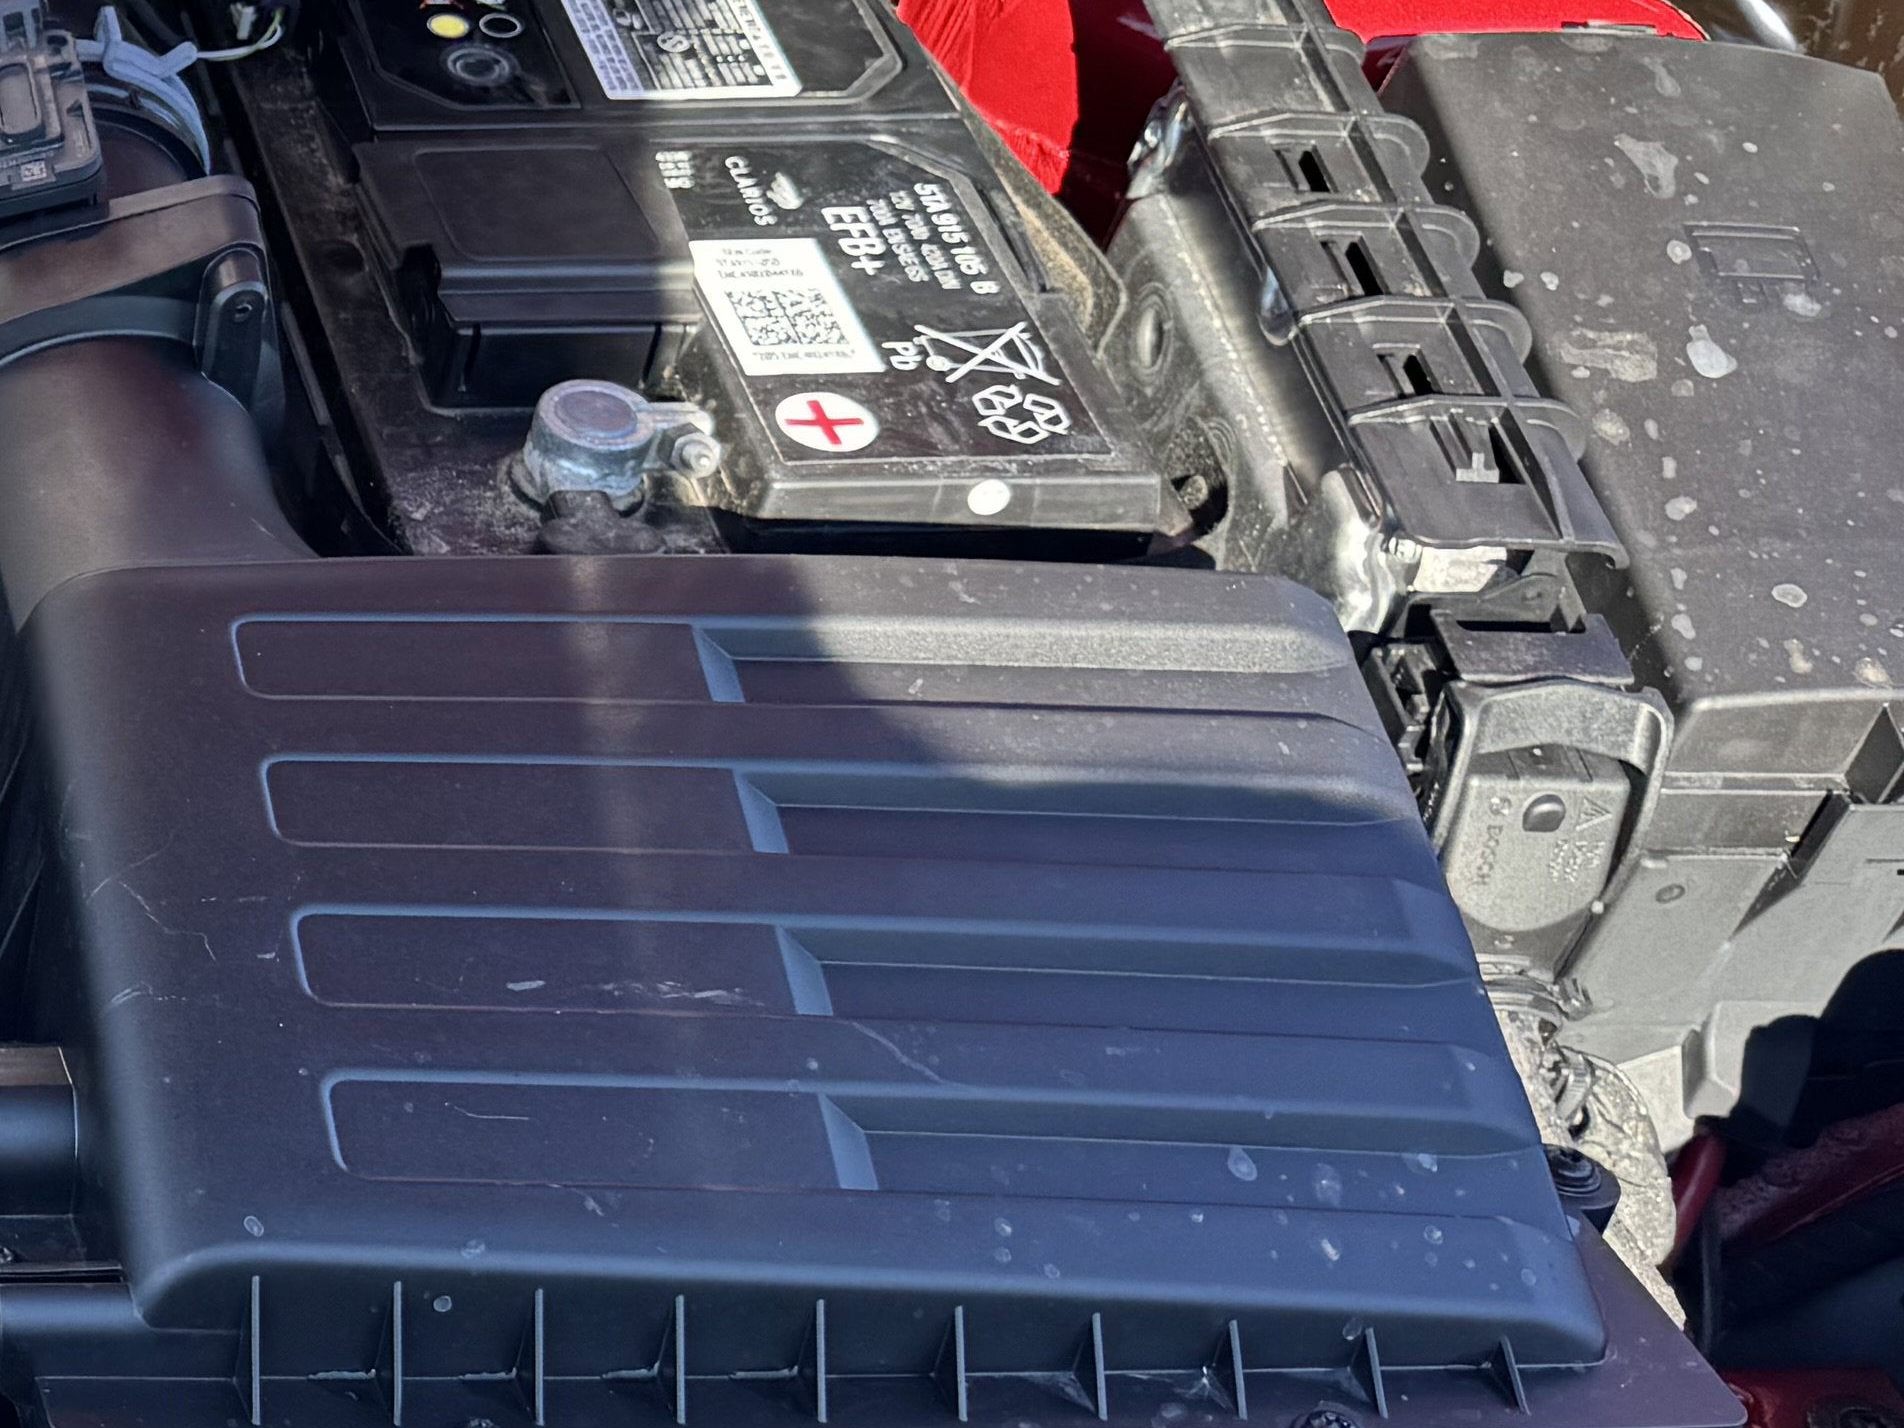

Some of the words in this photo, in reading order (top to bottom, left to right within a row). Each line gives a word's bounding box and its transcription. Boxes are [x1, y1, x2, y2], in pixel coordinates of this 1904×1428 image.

[725, 156, 779, 226] CLARIOS
[821, 207, 887, 276] EFB+
[931, 213, 970, 243] 915
[881, 341, 923, 371] Pb
